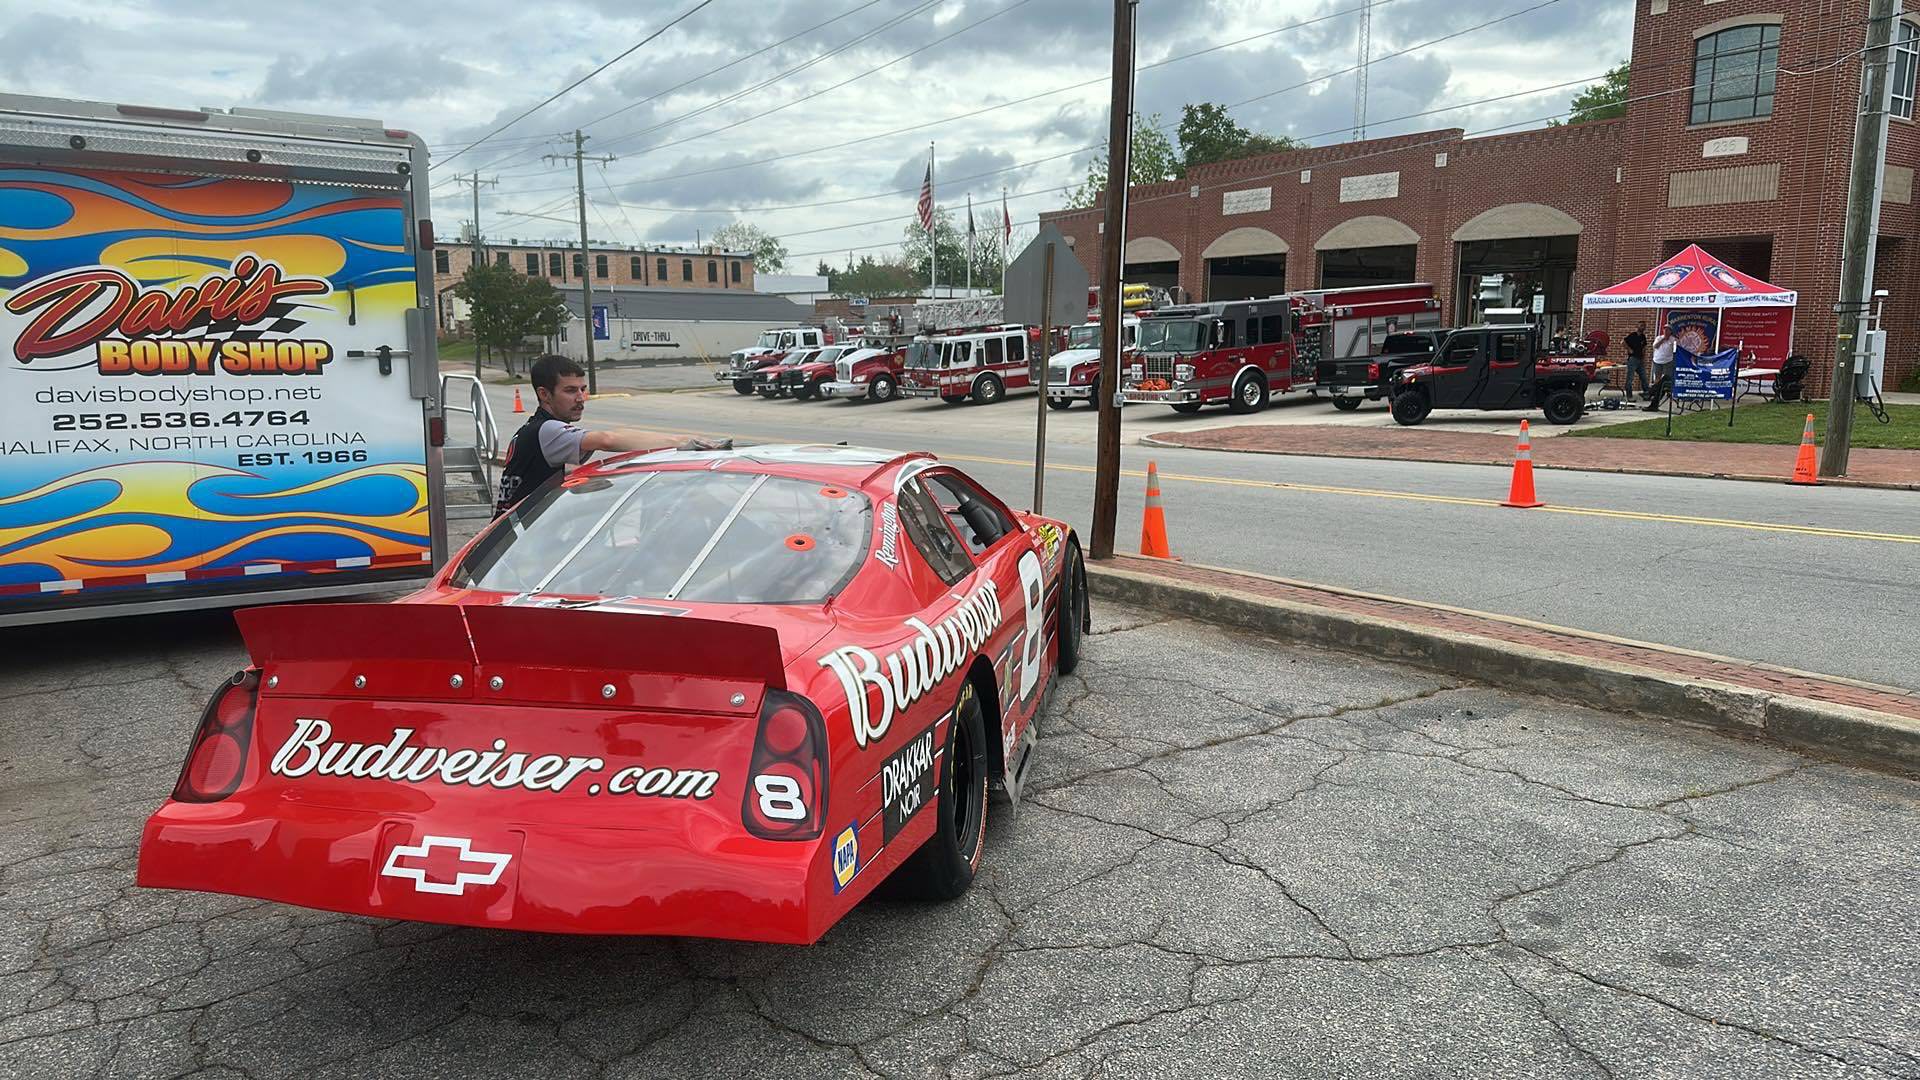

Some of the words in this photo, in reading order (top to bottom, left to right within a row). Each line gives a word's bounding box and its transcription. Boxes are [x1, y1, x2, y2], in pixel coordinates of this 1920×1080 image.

[5, 255, 331, 363] Davis
[1628, 296, 1650, 304] RURAL
[633, 331, 671, 342] DRIVE-THRU
[97, 338, 219, 376] BODY
[220, 338, 334, 376] SHOP
[35, 385, 321, 405] davisbodyshop.net
[53, 410, 310, 432] 252.536.4764
[0, 438, 119, 455] ALIFAX,
[130, 436, 228, 451] NORTH
[236, 431, 367, 448] CAROLINA
[238, 453, 295, 467] EST.
[303, 450, 368, 465] 1966
[874, 501, 900, 570] Remington
[1016, 549, 1045, 702] 8
[817, 579, 1003, 747] Budweiser
[269, 717, 721, 799] Budweiser.com
[882, 731, 934, 808] DRAKKAR
[753, 774, 806, 821] 8
[899, 783, 921, 824] NOIR
[837, 839, 855, 874] NAPA
